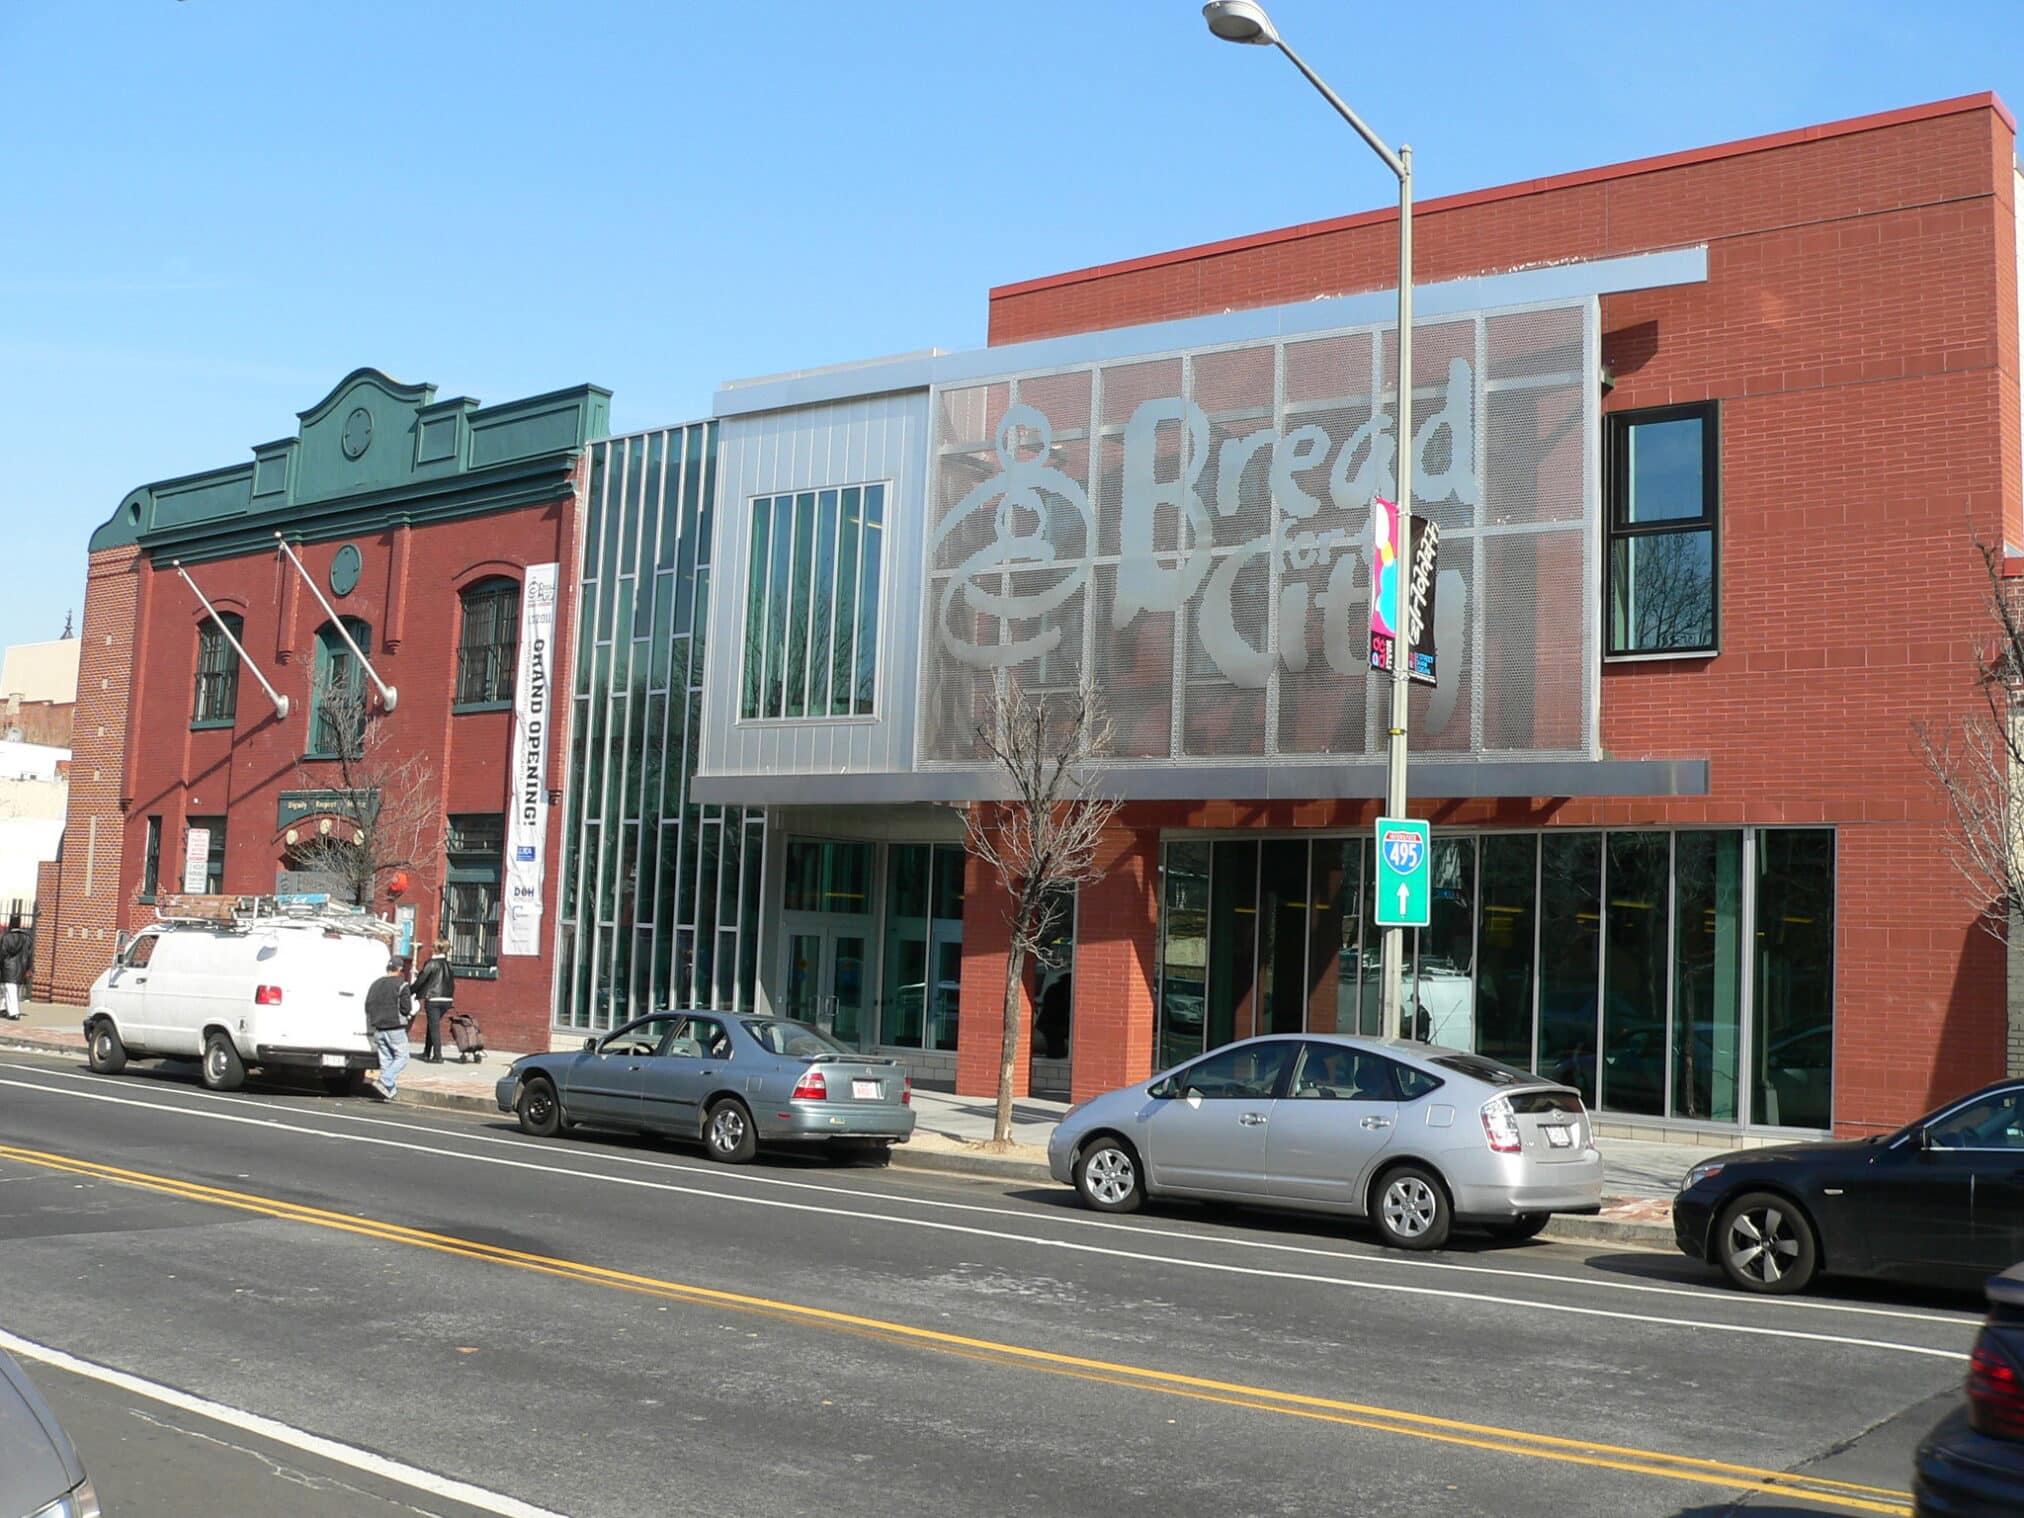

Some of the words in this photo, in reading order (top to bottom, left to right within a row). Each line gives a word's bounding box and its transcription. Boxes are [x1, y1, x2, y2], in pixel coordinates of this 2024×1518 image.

[1112, 356, 1475, 631] Bread
[530, 638, 545, 714] GRAND
[1198, 530, 1467, 735] City
[522, 720, 542, 827] OPENING!
[1390, 842, 1418, 867] 495
